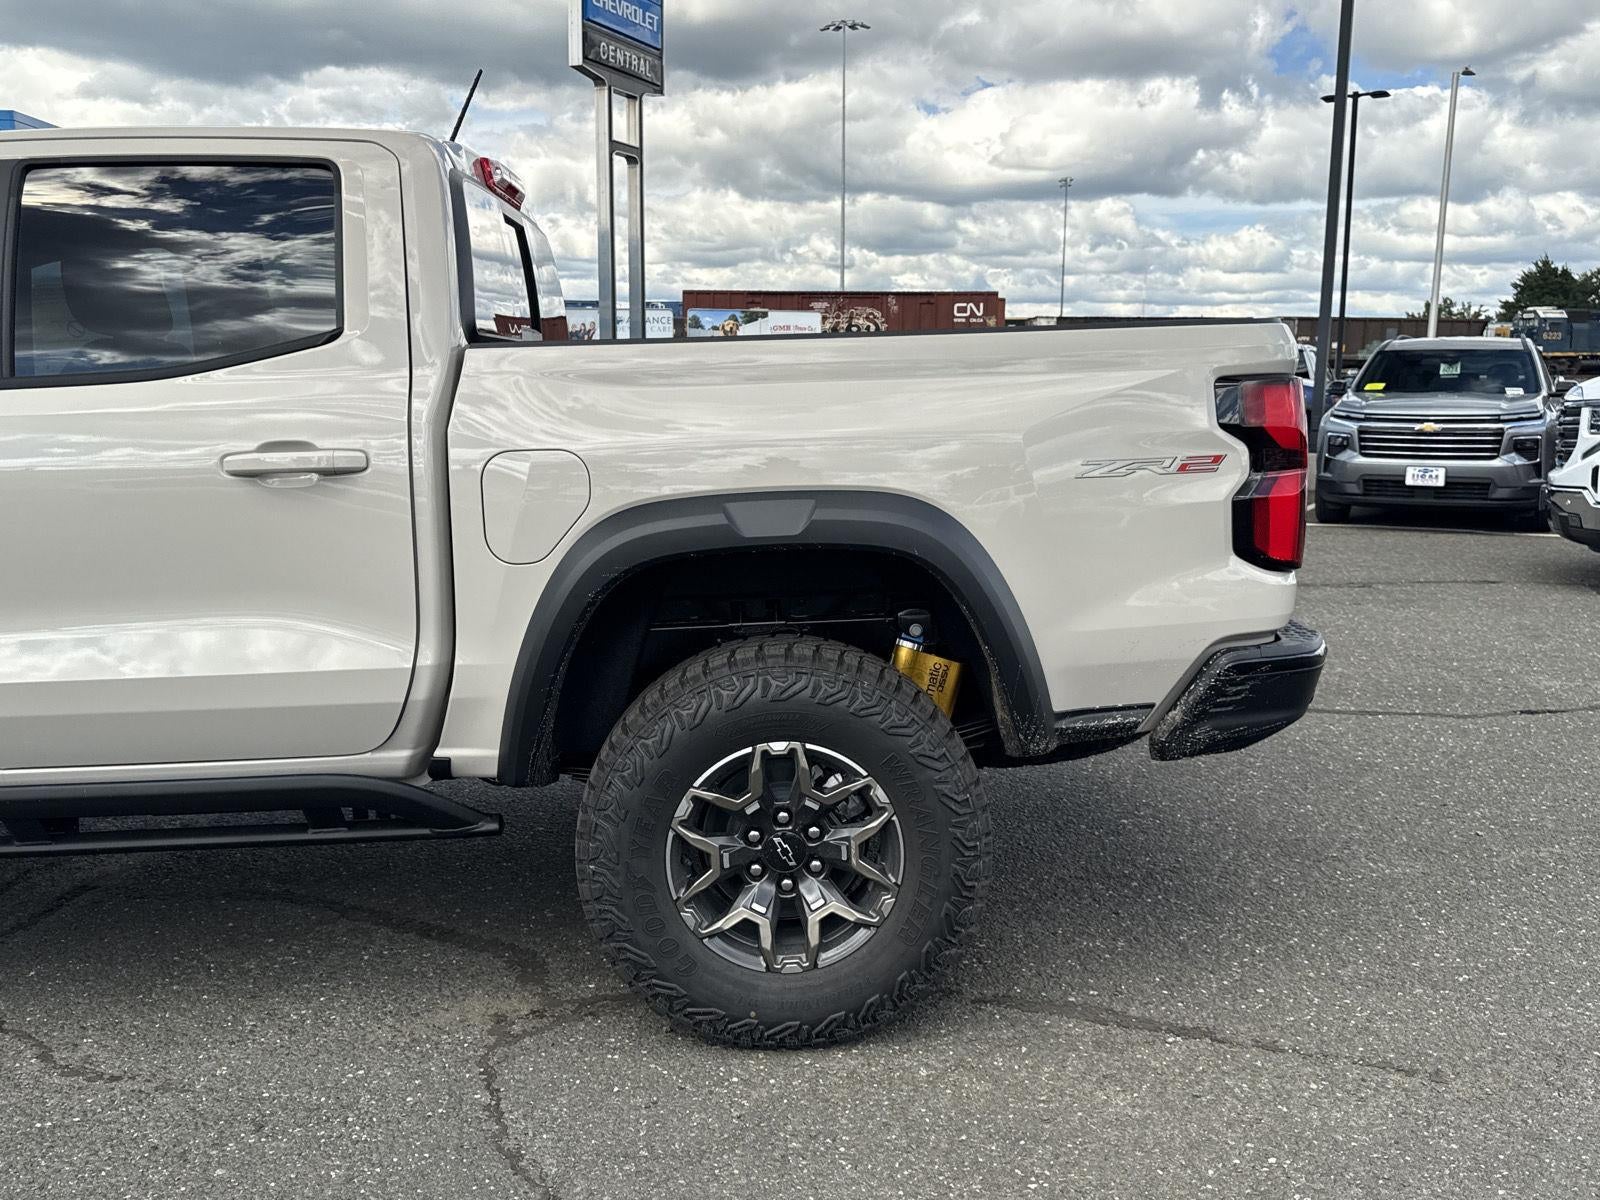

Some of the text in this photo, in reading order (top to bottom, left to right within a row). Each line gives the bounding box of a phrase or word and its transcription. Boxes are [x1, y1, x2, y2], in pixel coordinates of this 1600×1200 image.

[600, 42, 652, 77] CENTRAL
[953, 302, 984, 317] CN
[1074, 453, 1228, 479] ZR2
